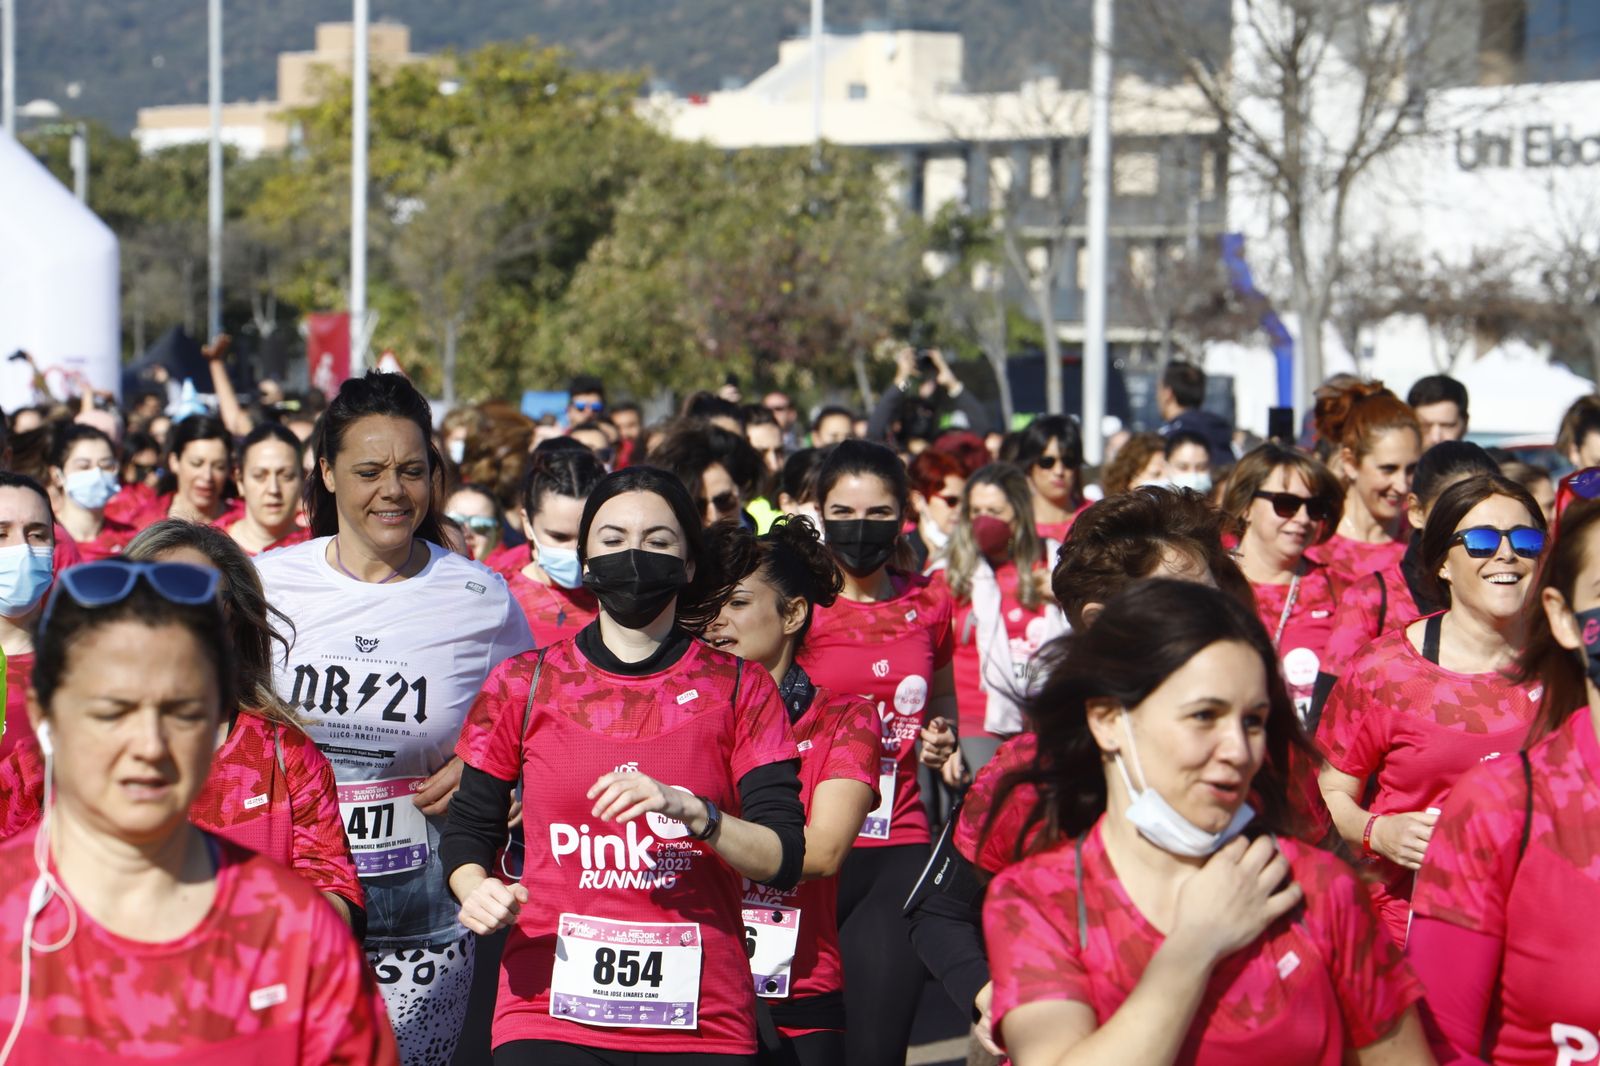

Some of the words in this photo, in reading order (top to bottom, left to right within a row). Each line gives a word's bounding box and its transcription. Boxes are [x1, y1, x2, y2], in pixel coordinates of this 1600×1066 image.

[355, 635, 380, 647] Rock
[334, 758, 365, 767] septiembre
[348, 803, 394, 839] 477
[550, 821, 657, 870] Pink
[665, 841, 692, 850] EDICIÓN
[656, 849, 662, 858] 6
[664, 850, 675, 858] de
[678, 849, 703, 858] marzo
[657, 858, 692, 871] 2022
[578, 870, 676, 889] RUNNING
[607, 935, 636, 943] VARIEDAD
[616, 930, 627, 938] LA
[628, 932, 655, 941] MEJOR
[593, 946, 663, 988] 854
[592, 988, 608, 996] MARIA
[623, 991, 643, 999] LINARES
